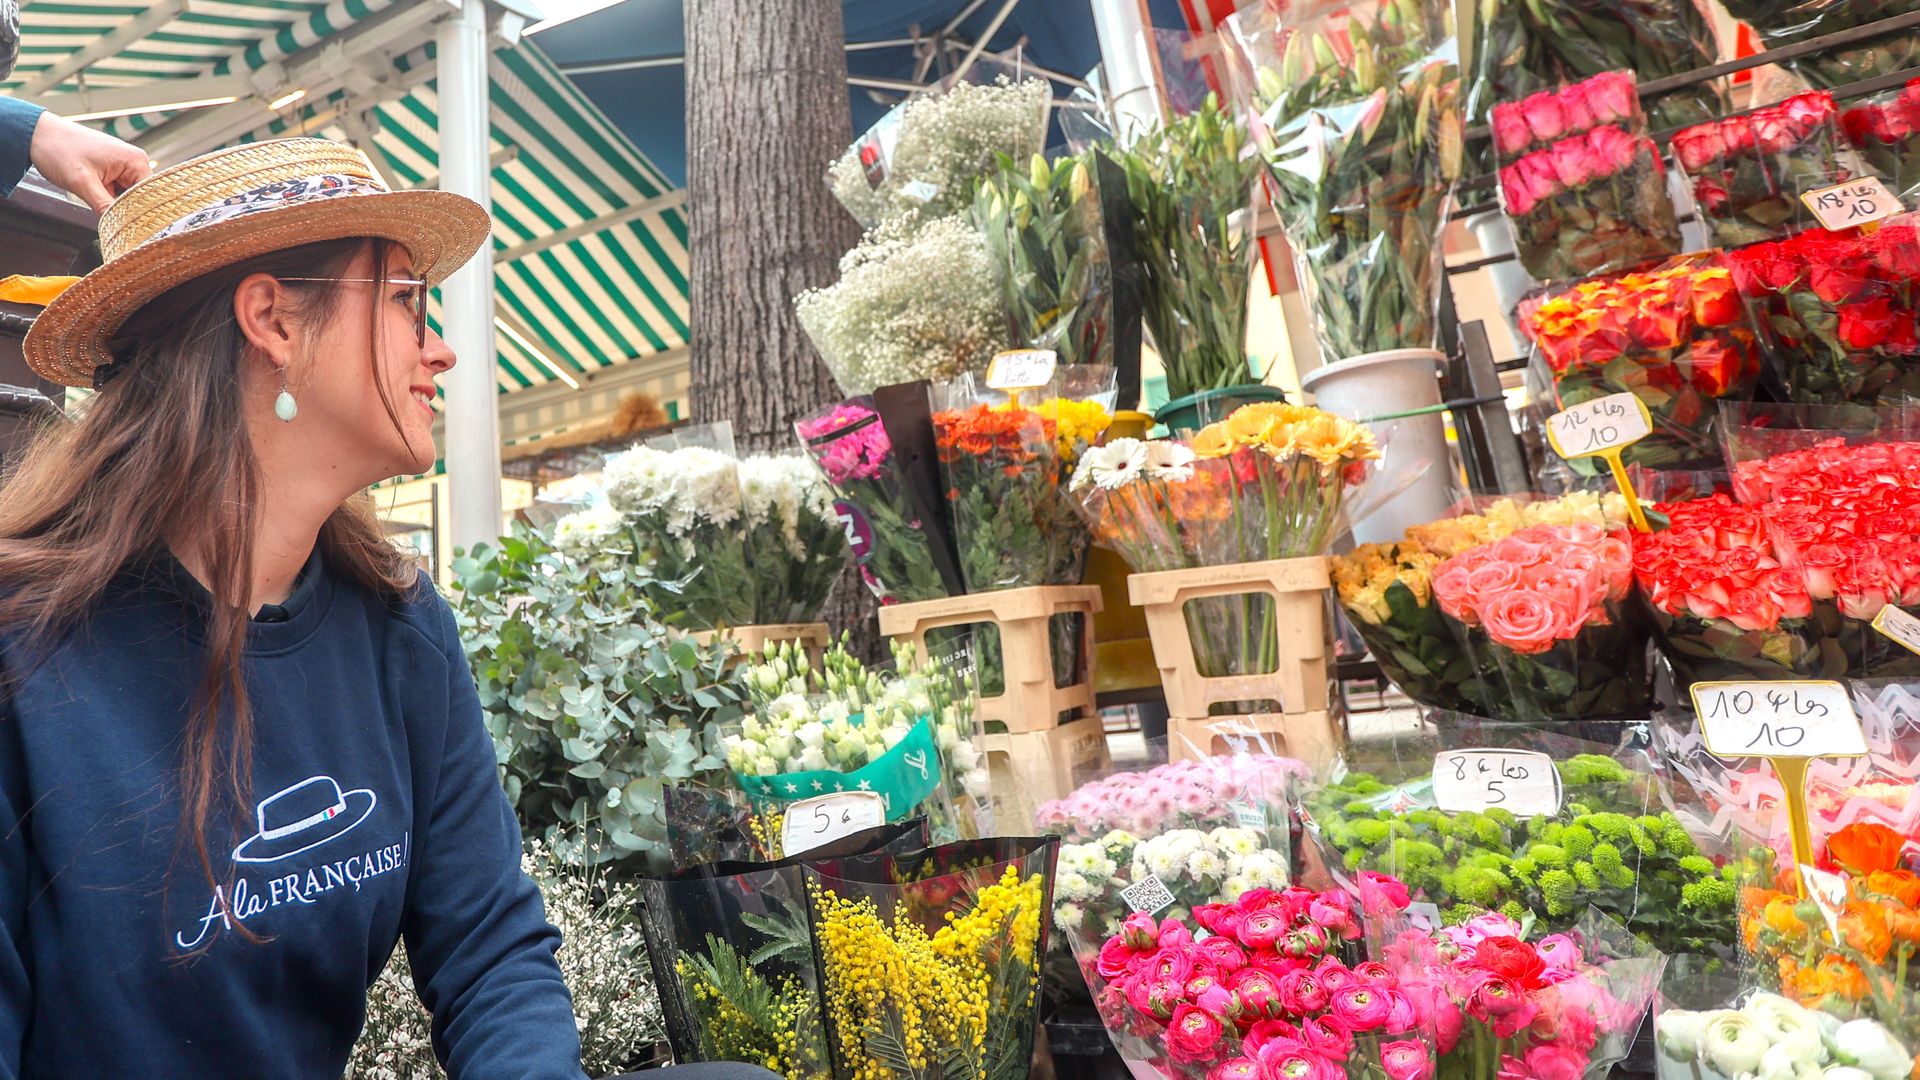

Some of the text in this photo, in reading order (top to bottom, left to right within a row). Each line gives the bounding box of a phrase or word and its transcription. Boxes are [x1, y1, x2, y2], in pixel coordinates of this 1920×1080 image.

[1817, 192, 1845, 211] 18
[1847, 199, 1877, 220] 10
[1562, 410, 1589, 430] 12
[1584, 425, 1619, 451] 10
[1709, 690, 1754, 719] 10
[1745, 722, 1805, 749] 10
[1448, 755, 1466, 781] 8
[1485, 780, 1506, 804] 5
[813, 803, 831, 834] 5
[233, 877, 268, 920] la
